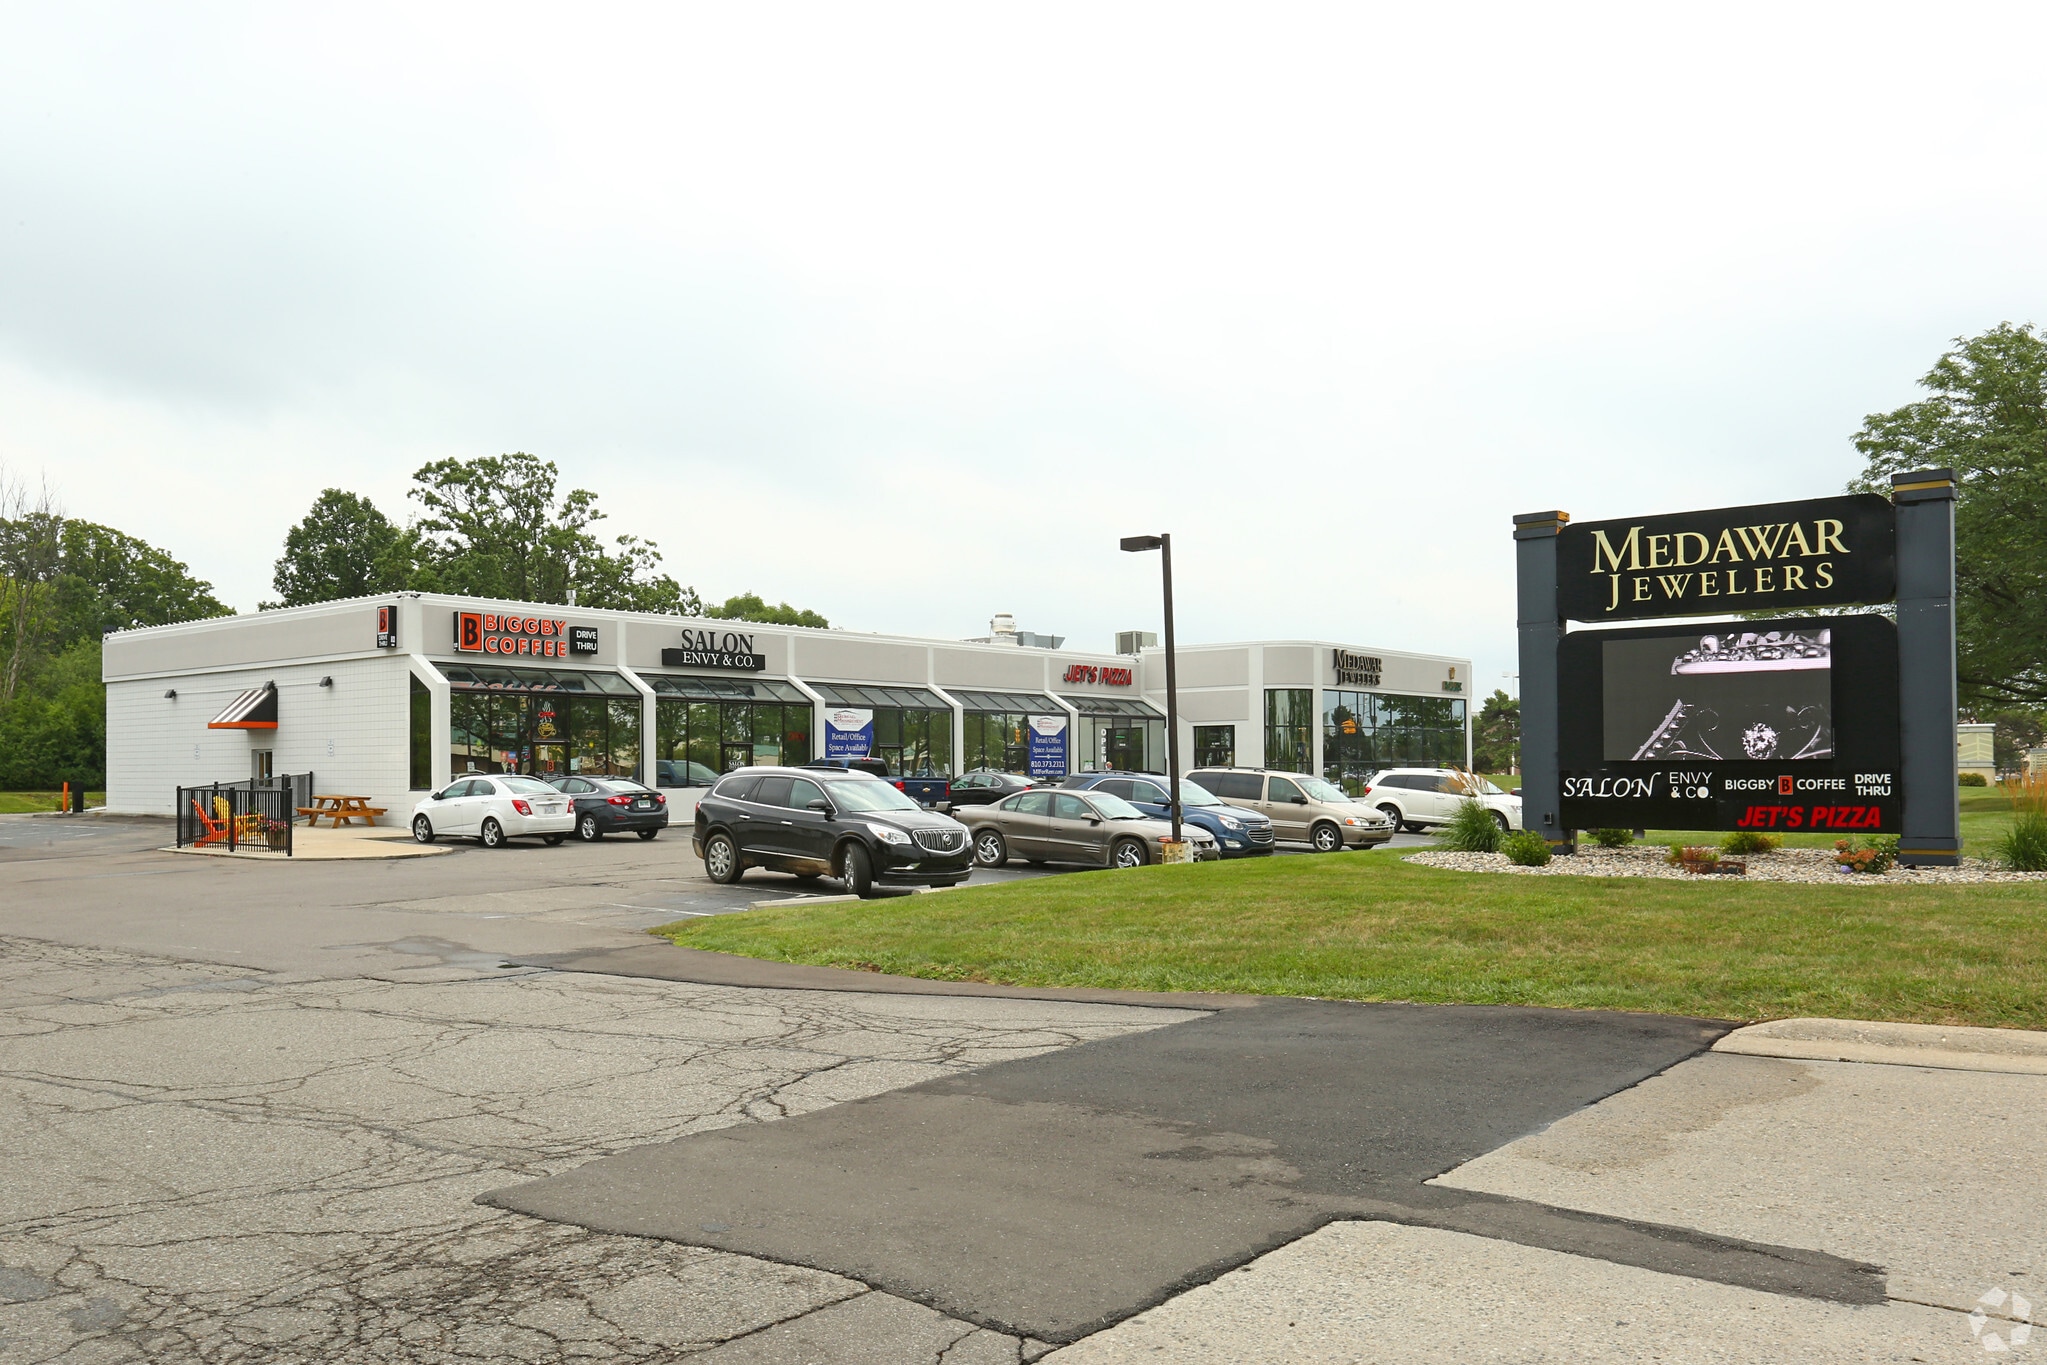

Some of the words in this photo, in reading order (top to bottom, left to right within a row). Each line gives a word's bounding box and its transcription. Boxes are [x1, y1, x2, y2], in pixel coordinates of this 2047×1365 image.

[1590, 519, 1851, 574] MEDAWAR
[1605, 562, 1834, 612] JEWELERS
[464, 617, 478, 647] B
[484, 613, 567, 637] BIGGBY
[576, 629, 597, 641] DRIVE
[681, 628, 754, 655] SALON
[485, 635, 567, 658] COFFEE
[576, 640, 597, 652] THRU
[682, 651, 720, 665] ENVY
[722, 654, 732, 667] &
[735, 655, 755, 668] CO.
[1333, 648, 1382, 673] MEDAWAR
[1065, 665, 1098, 683] JET'S
[1100, 667, 1132, 686] PIZZA
[831, 732, 866, 741] Retail/Office
[828, 743, 844, 753] Space
[1563, 772, 1662, 798] SALON
[1669, 771, 1713, 785] ENVY
[1724, 779, 1775, 791] BIGGBY
[1796, 778, 1846, 791] COFFEE
[1854, 773, 1892, 785] DRIVE
[1670, 786, 1681, 798] &
[1685, 786, 1713, 799] CO.
[1855, 785, 1892, 797] THRU
[1737, 805, 1804, 828] JET'S
[1809, 806, 1881, 829] PIZZA
